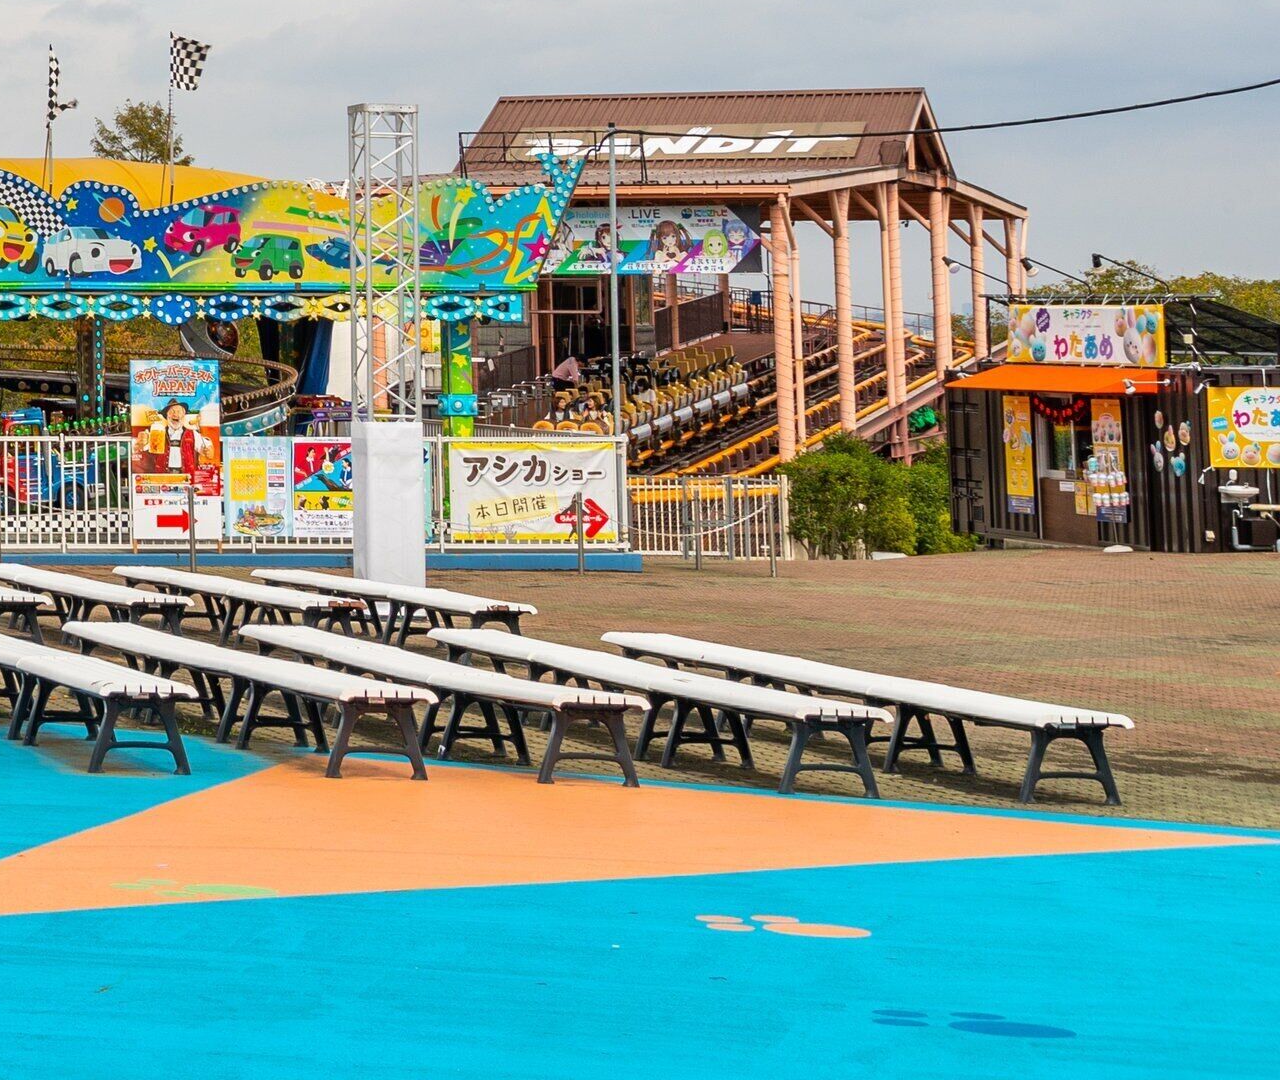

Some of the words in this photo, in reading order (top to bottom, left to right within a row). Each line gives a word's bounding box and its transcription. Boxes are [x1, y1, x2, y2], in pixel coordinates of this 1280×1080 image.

[1062, 309, 1100, 320] キャラクター
[1053, 331, 1114, 360] わたあめ
[135, 365, 214, 383] オクトーバーフェスト
[153, 380, 197, 396] JAPAN
[462, 454, 603, 483] アシカショー
[476, 494, 548, 520] 本日開催
